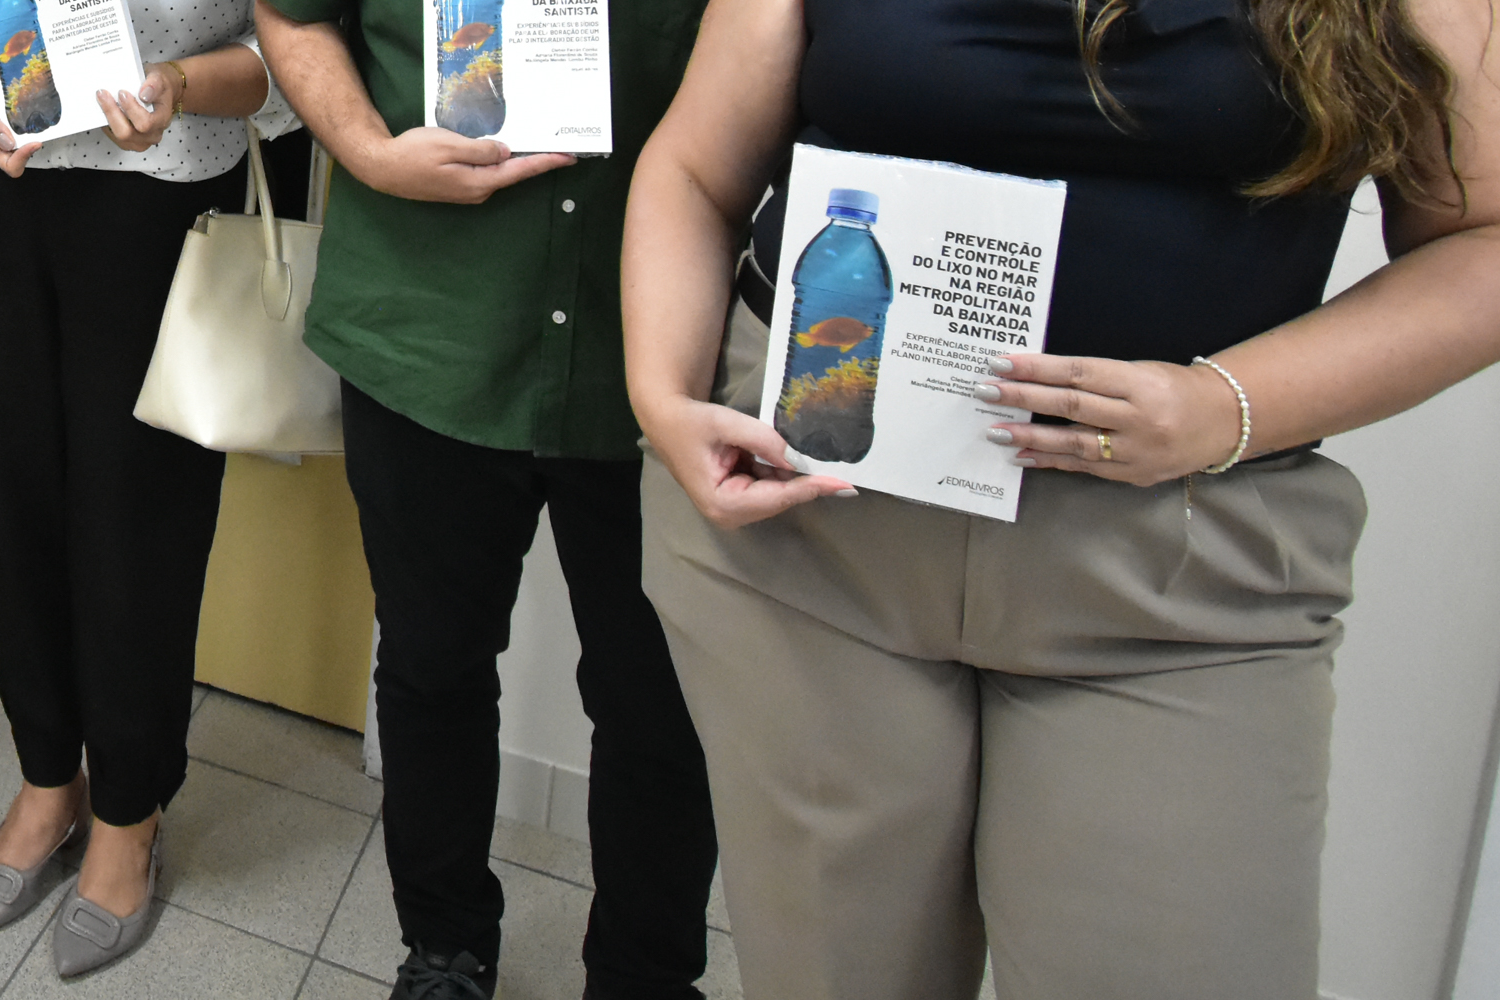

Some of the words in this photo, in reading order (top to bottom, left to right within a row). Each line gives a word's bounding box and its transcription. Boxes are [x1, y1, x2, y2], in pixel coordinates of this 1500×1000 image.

[544, 7, 598, 16] SANTISTA
[945, 231, 1042, 258] PREVENÇÃO
[913, 255, 934, 269] DO
[937, 260, 972, 276] LIXO
[976, 267, 998, 281] NO
[1002, 271, 1037, 288] MAR
[942, 245, 951, 257] E
[954, 248, 1040, 273] CONTROLE
[900, 282, 1033, 318] METROPOLITANA
[950, 276, 972, 291] NA
[976, 282, 1035, 303] REGIÃO
[933, 304, 955, 318] DA
[958, 308, 1031, 332] BAIXADA
[907, 333, 969, 351] EXPERIÊNCIAS
[948, 322, 1029, 347] SANTISTA
[891, 349, 921, 361] PLANO
[923, 356, 972, 372] INTEGRADO
[974, 366, 986, 375] DE
[902, 342, 925, 352] PARA
[935, 349, 989, 366] ELABORAÇÃ
[911, 381, 945, 392] Mariângela
[947, 388, 971, 397] Mendes
[926, 378, 951, 387] Adriana
[952, 383, 976, 392] Florent
[950, 376, 970, 384] Cleber
[946, 476, 1004, 496] EDITALIVROS
